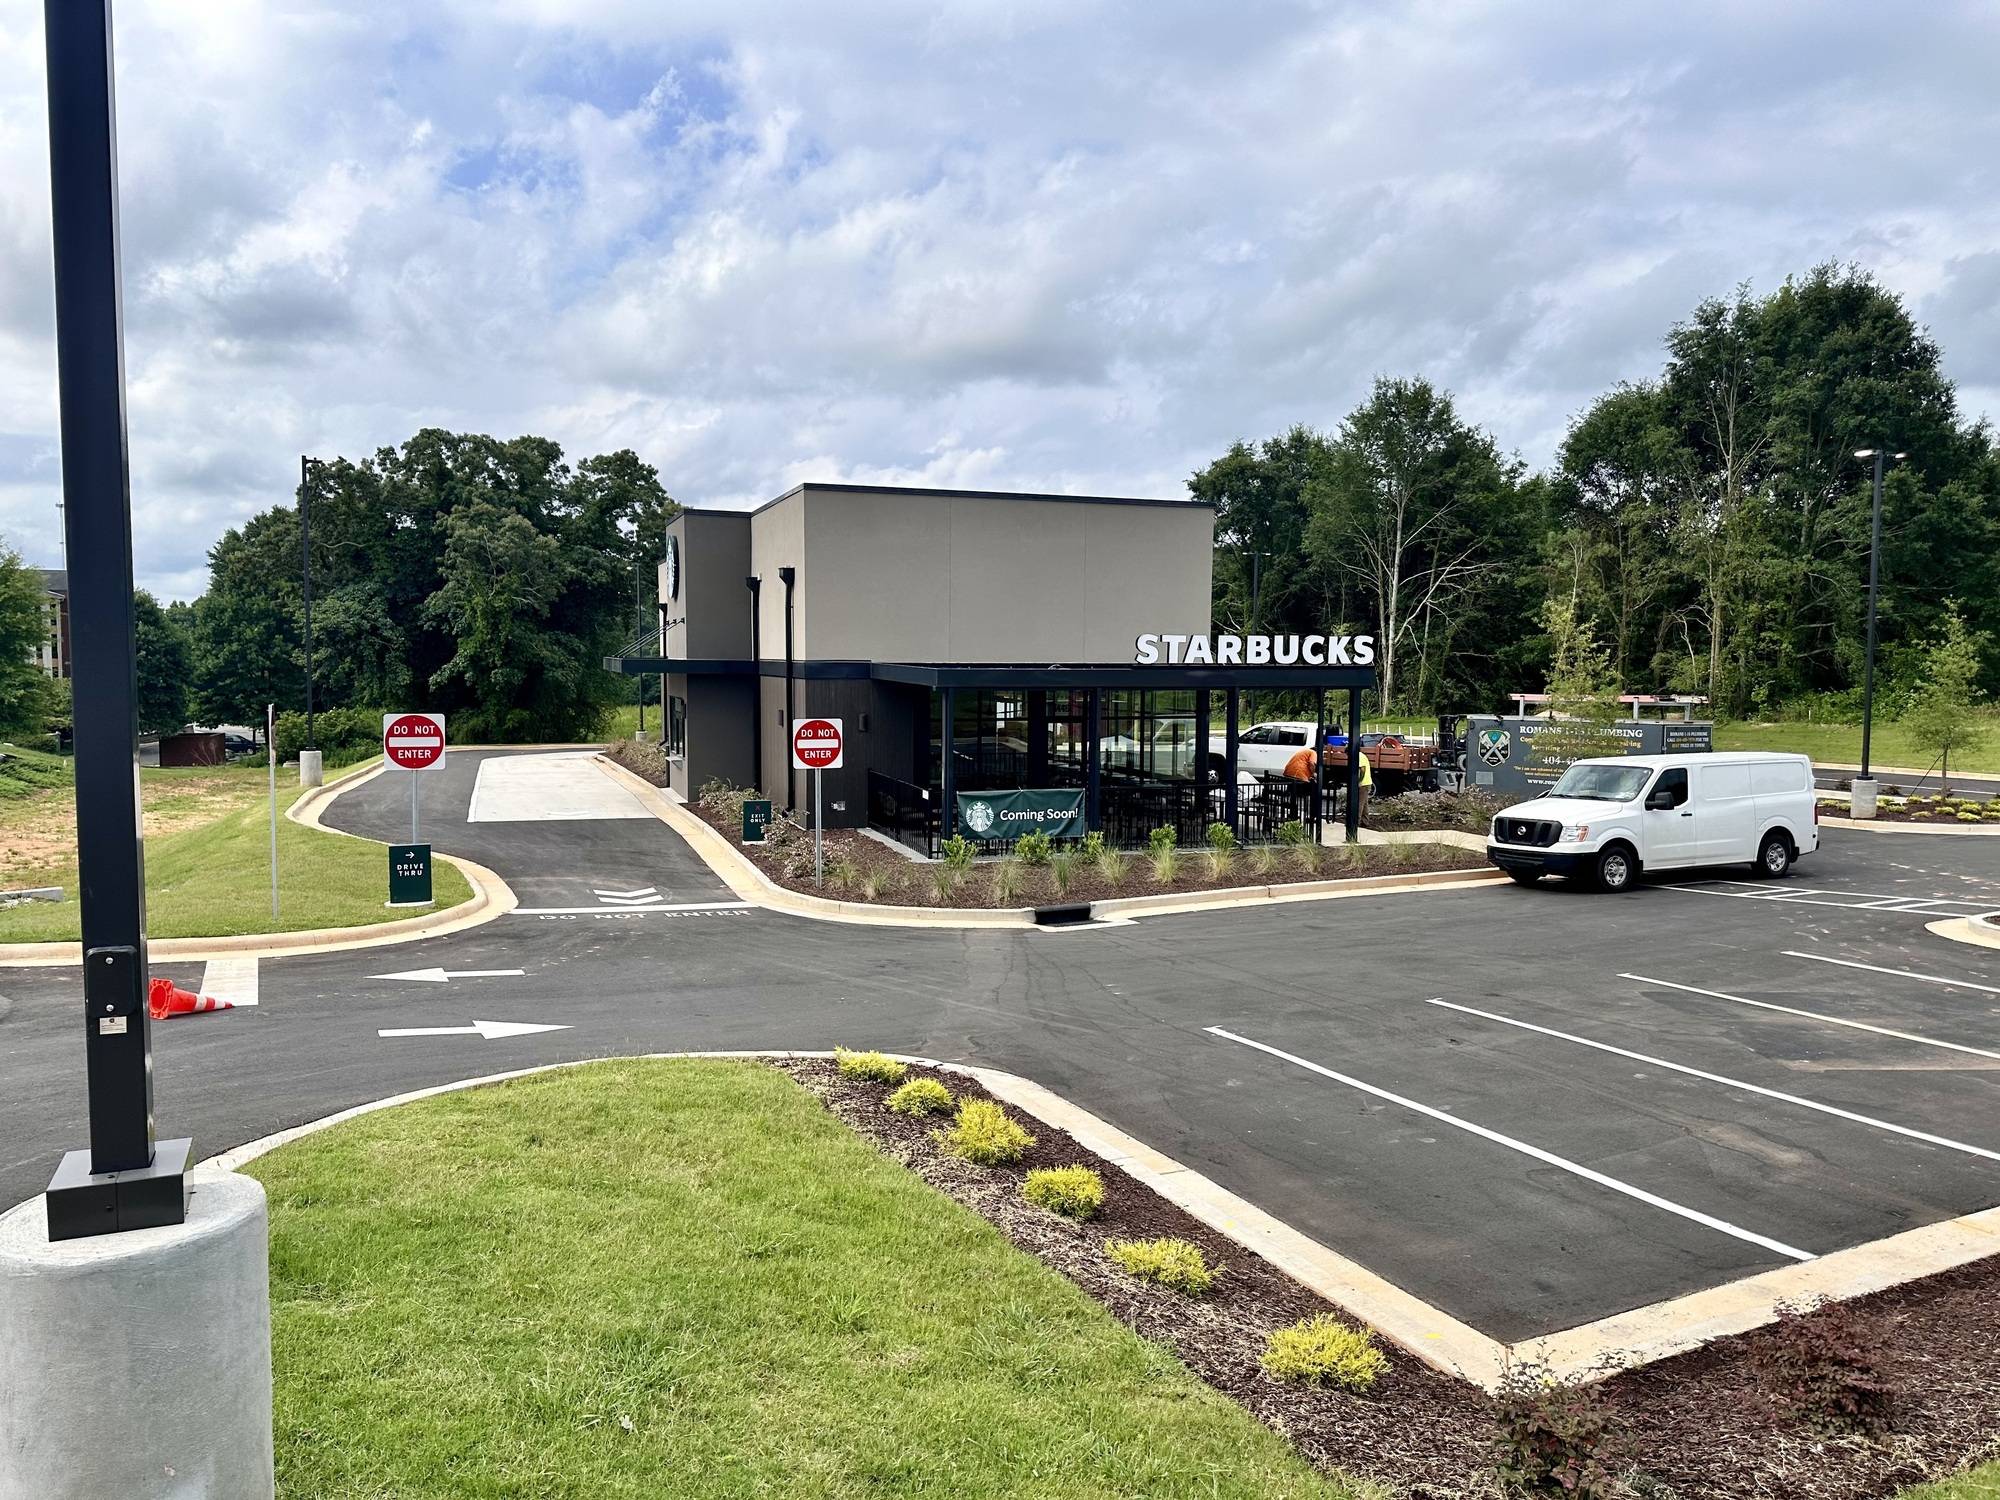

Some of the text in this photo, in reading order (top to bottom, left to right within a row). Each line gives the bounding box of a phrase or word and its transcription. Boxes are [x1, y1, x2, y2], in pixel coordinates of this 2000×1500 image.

[1135, 633, 1374, 665] STARBUCKS
[393, 725, 436, 735] DO NOT
[800, 729, 835, 738] DO NOT
[1519, 725, 1562, 735] ROMANS
[1587, 728, 1644, 738] UMBING
[397, 749, 432, 759] ENTER
[804, 750, 832, 759] ENTER
[1542, 756, 1577, 766] 404-40
[1000, 807, 1079, 822] Coming Soon!
[396, 863, 424, 871] DRIVE
[398, 869, 423, 877] THRU
[664, 909, 752, 919] ENTER
